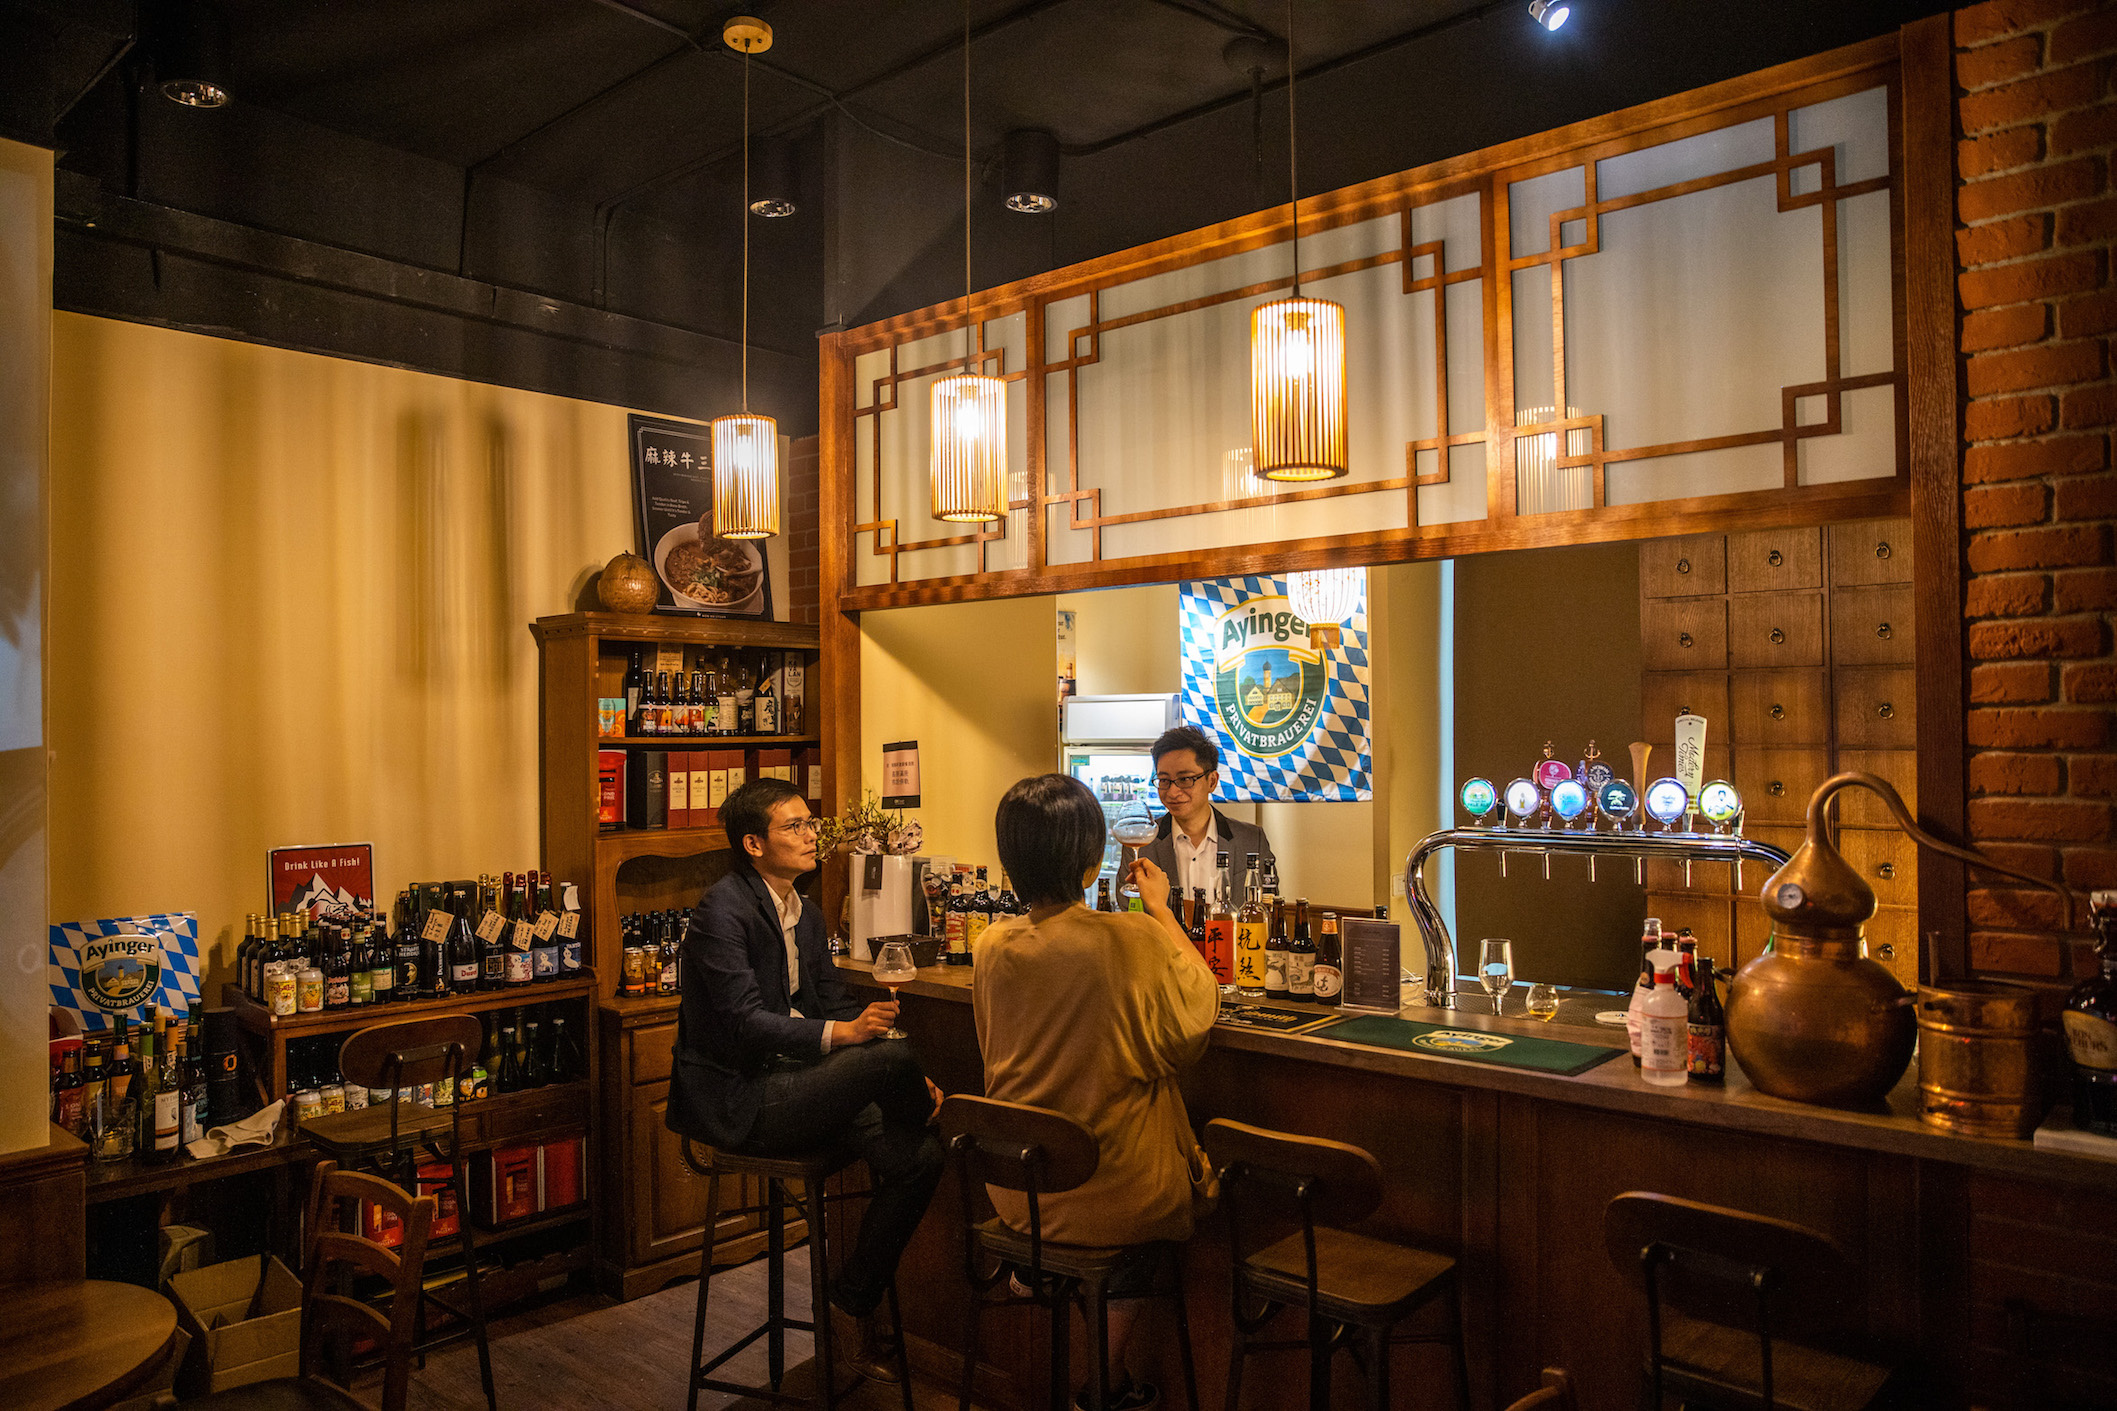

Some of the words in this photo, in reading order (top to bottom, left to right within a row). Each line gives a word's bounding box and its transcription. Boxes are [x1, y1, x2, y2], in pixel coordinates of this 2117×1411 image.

[645, 446, 712, 471] 麻辣牛三
[1225, 697, 1317, 748] PRIVATBRAUEREI
[284, 861, 308, 871] Drink
[310, 859, 328, 869] Like
[331, 858, 336, 868] A
[339, 857, 360, 867] Fish!
[86, 938, 155, 961] Ayinger
[1207, 927, 1229, 977] 平安
[88, 980, 155, 1007] PRIVATBRAUEREI
